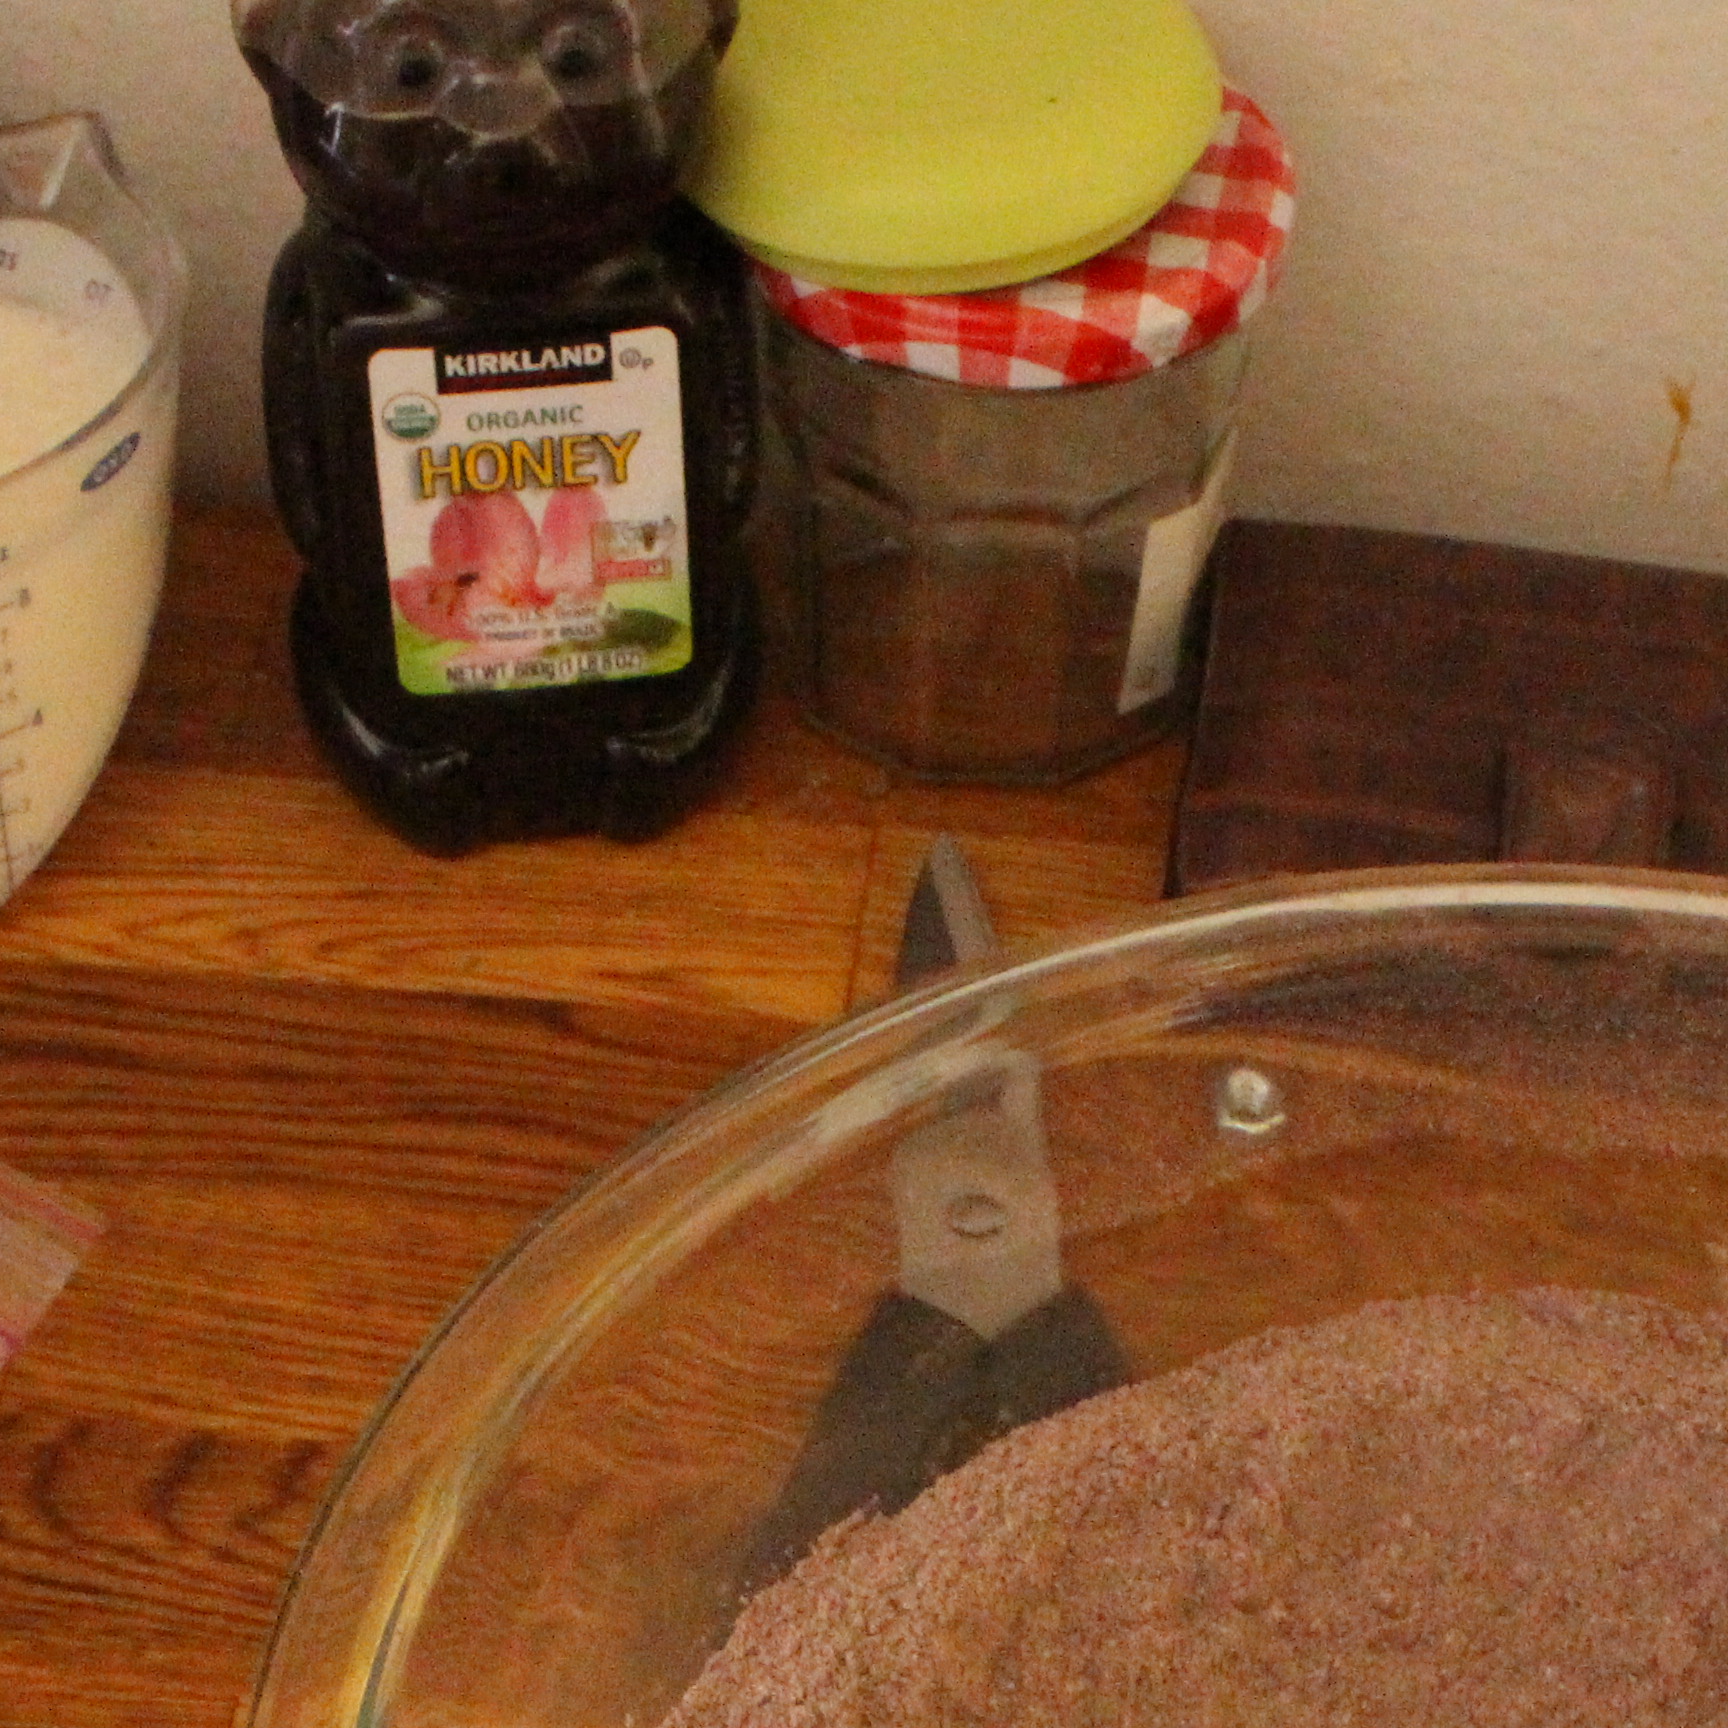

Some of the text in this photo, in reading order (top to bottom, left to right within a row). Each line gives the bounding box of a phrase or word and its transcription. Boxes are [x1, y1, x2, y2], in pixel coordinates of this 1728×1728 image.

[443, 343, 606, 378] KIRKLAND
[466, 404, 585, 433] ORGANIC
[418, 428, 642, 500] HONEY
